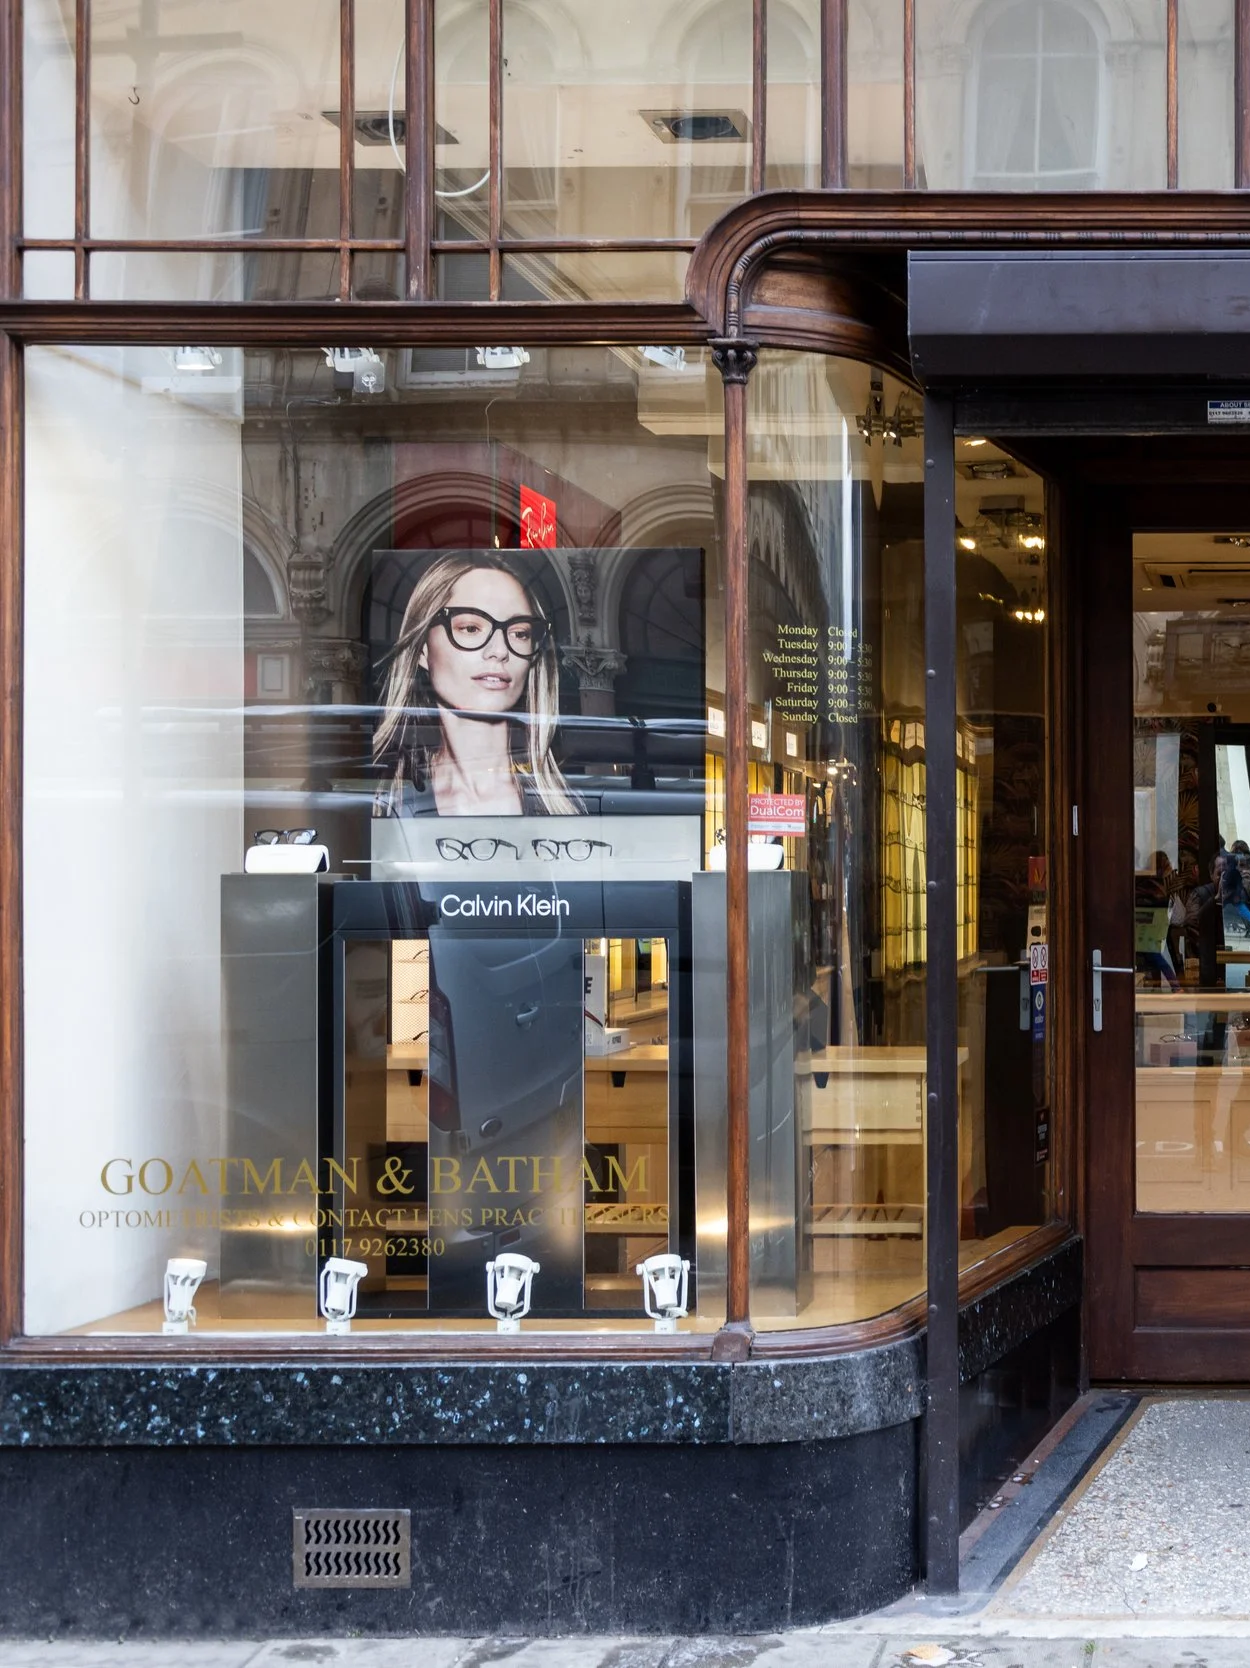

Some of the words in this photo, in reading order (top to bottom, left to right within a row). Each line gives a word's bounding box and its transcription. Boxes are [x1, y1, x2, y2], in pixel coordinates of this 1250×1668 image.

[778, 624, 818, 637] Monday
[828, 626, 857, 638] Cloed
[778, 639, 818, 652] Tuesday
[828, 641, 847, 651] 9:00
[763, 653, 818, 666] Wednesday
[828, 655, 847, 666] 9:00
[772, 667, 818, 680] Thursday
[828, 670, 848, 680] 9:00
[787, 682, 818, 695] Friday
[828, 684, 848, 694] 9:00
[775, 696, 819, 709] Saturday
[828, 698, 848, 708] 9:00
[782, 711, 818, 724] Sunday
[828, 712, 858, 723] Closed
[750, 798, 794, 806] PROTECTED
[795, 799, 804, 807] BY
[750, 805, 804, 817] DualCom
[440, 894, 512, 917] Calvin
[517, 894, 569, 917] Klein
[100, 1156, 362, 1196] GOATMAN
[376, 1155, 415, 1195] &
[430, 1155, 649, 1194] BATHAM
[267, 1209, 286, 1227] &
[293, 1208, 405, 1228] CONTACT
[481, 1206, 670, 1228] PRACITIONERS
[305, 1238, 357, 1257] 0117
[360, 1237, 445, 1257] 9262380
